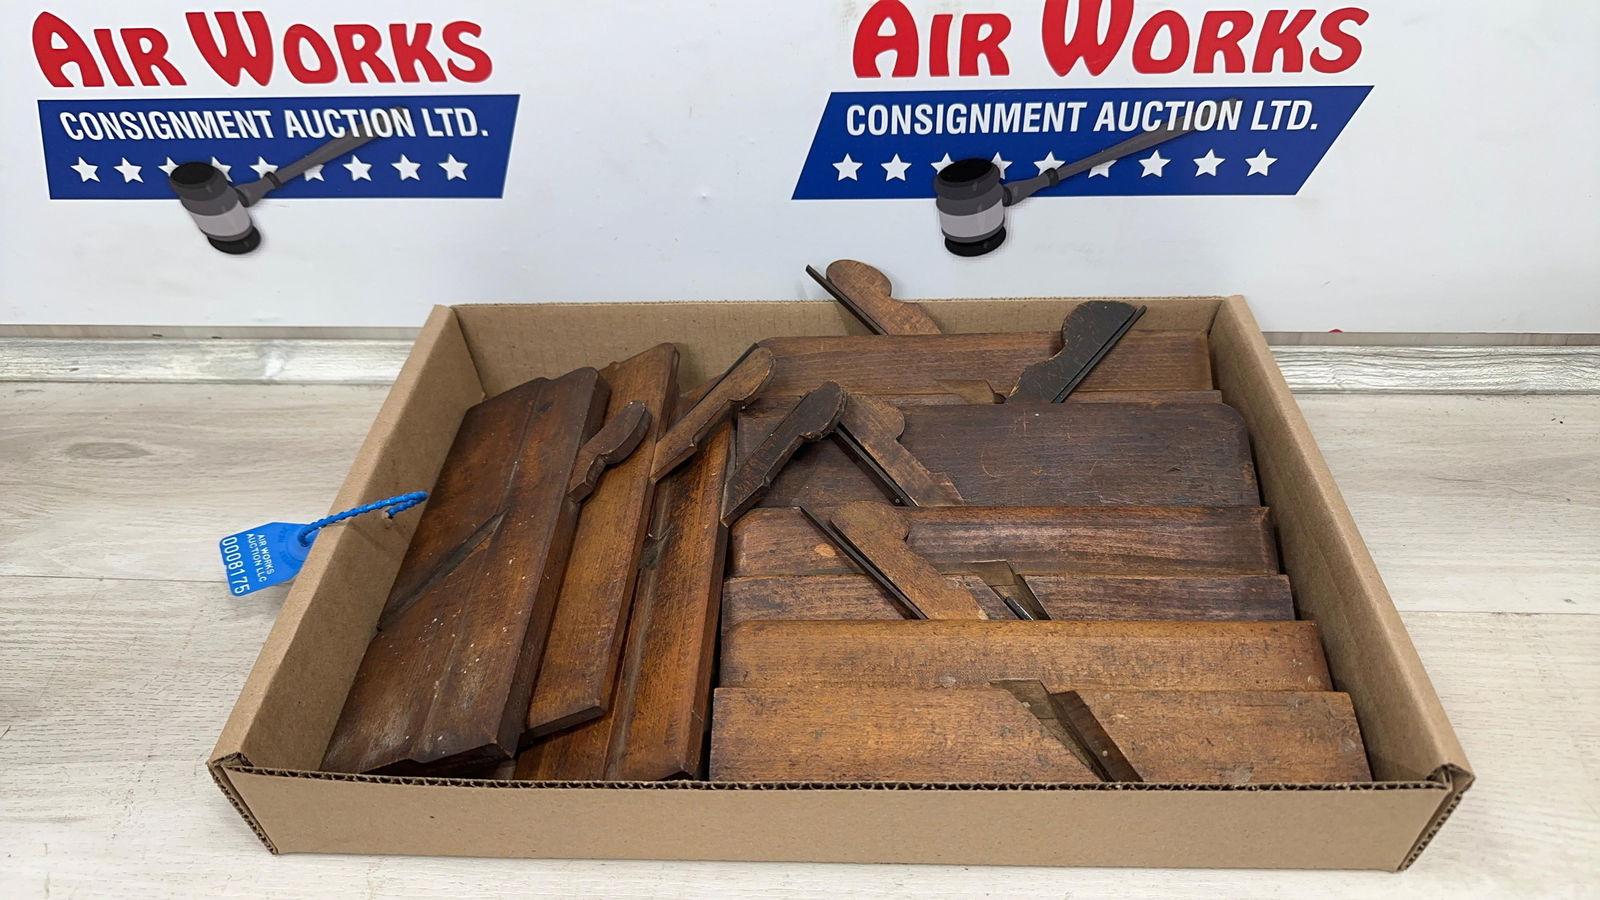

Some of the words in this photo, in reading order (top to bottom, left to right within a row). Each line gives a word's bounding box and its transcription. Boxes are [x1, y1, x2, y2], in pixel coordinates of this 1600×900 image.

[32, 11, 187, 87] AIR
[185, 11, 493, 87] WORKS
[852, 0, 1010, 78] AIR
[1041, 0, 1370, 77] WORKS
[59, 110, 273, 141] CONSIGNMENT
[284, 108, 416, 139] AUCTION
[425, 107, 489, 137] LTD.
[846, 101, 1087, 135] CONSIGNMENT
[1093, 100, 1240, 132] AUCTION
[1250, 100, 1319, 131] LTD.
[246, 533, 261, 567] AUCTION
[256, 567, 267, 583] LLC
[257, 534, 267, 547] AIR
[261, 547, 275, 575] WORKS
[222, 536, 250, 594] 0008175
